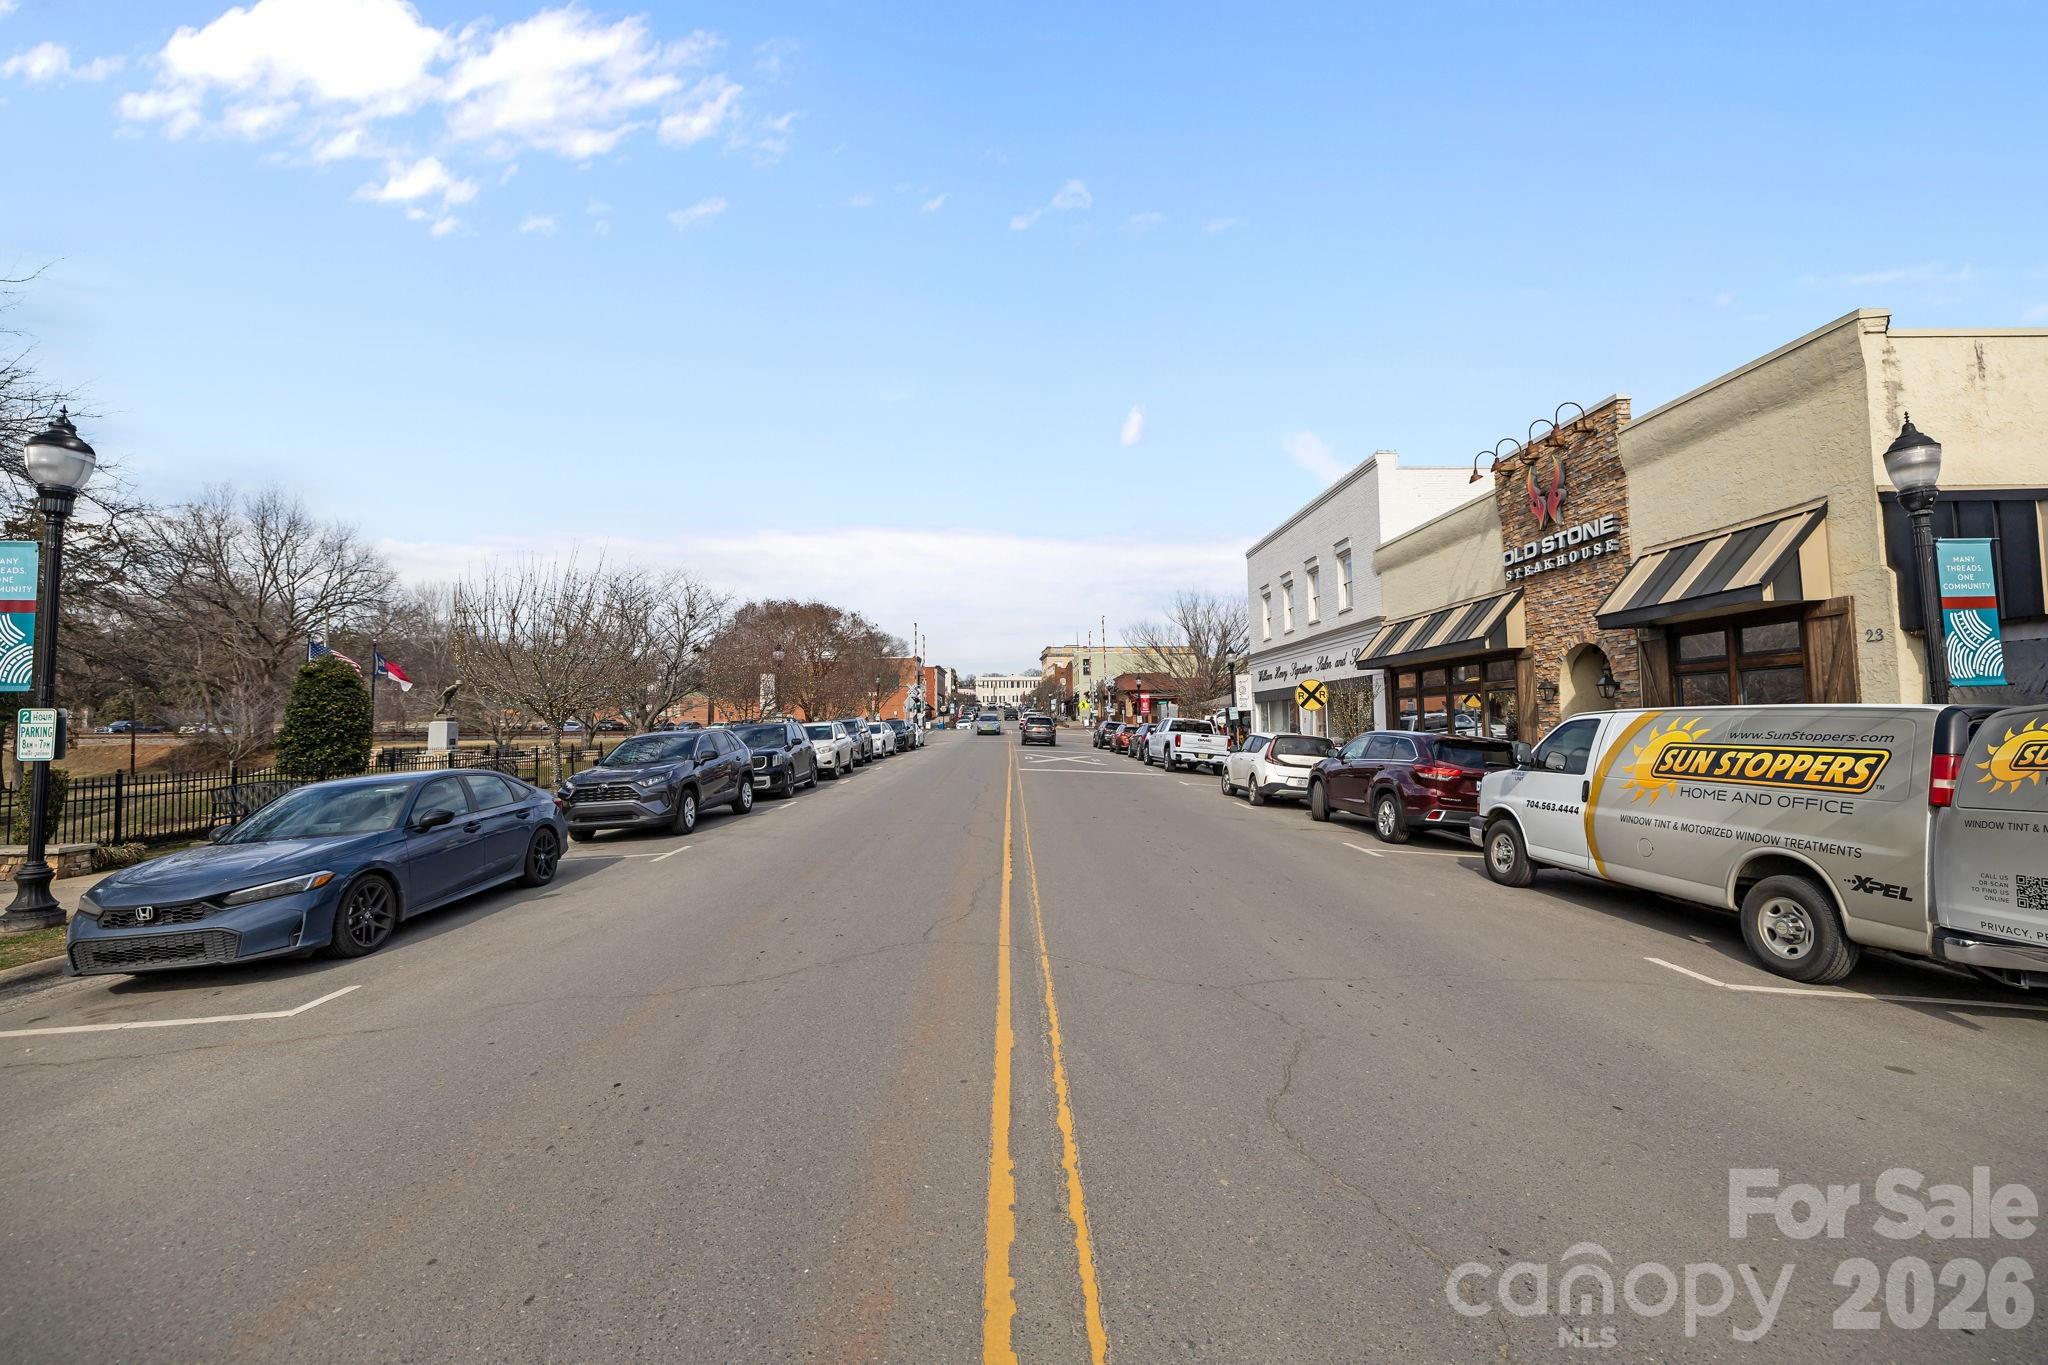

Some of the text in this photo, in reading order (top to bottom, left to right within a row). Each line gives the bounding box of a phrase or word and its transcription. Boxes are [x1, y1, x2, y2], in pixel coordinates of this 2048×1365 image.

[1503, 514, 1617, 567] OLD STONE
[1505, 539, 1617, 581] STEAKHOUSE
[1866, 628, 1884, 642] 23
[1316, 655, 1333, 672] Salon
[1335, 651, 1348, 668] and
[1298, 690, 1326, 700] R R
[22, 711, 30, 723] 2
[20, 727, 53, 738] PARKING
[1729, 730, 1895, 743] www.SunStoppers.com
[1660, 749, 1715, 775] SUN
[1714, 751, 1879, 785] STOPPERS
[1526, 800, 1580, 815] 704.563.4444
[1680, 786, 1855, 815] HOME AND OFFICE
[1964, 820, 2005, 830] WINDOW
[2007, 822, 2030, 832] TINT
[2032, 824, 2040, 832] &
[1620, 814, 1862, 858] WINDOW TINT & MOTORIZED WINDOW TREATMENTS
[1850, 874, 1913, 902] XPEL
[1984, 895, 2009, 903] ONLINE
